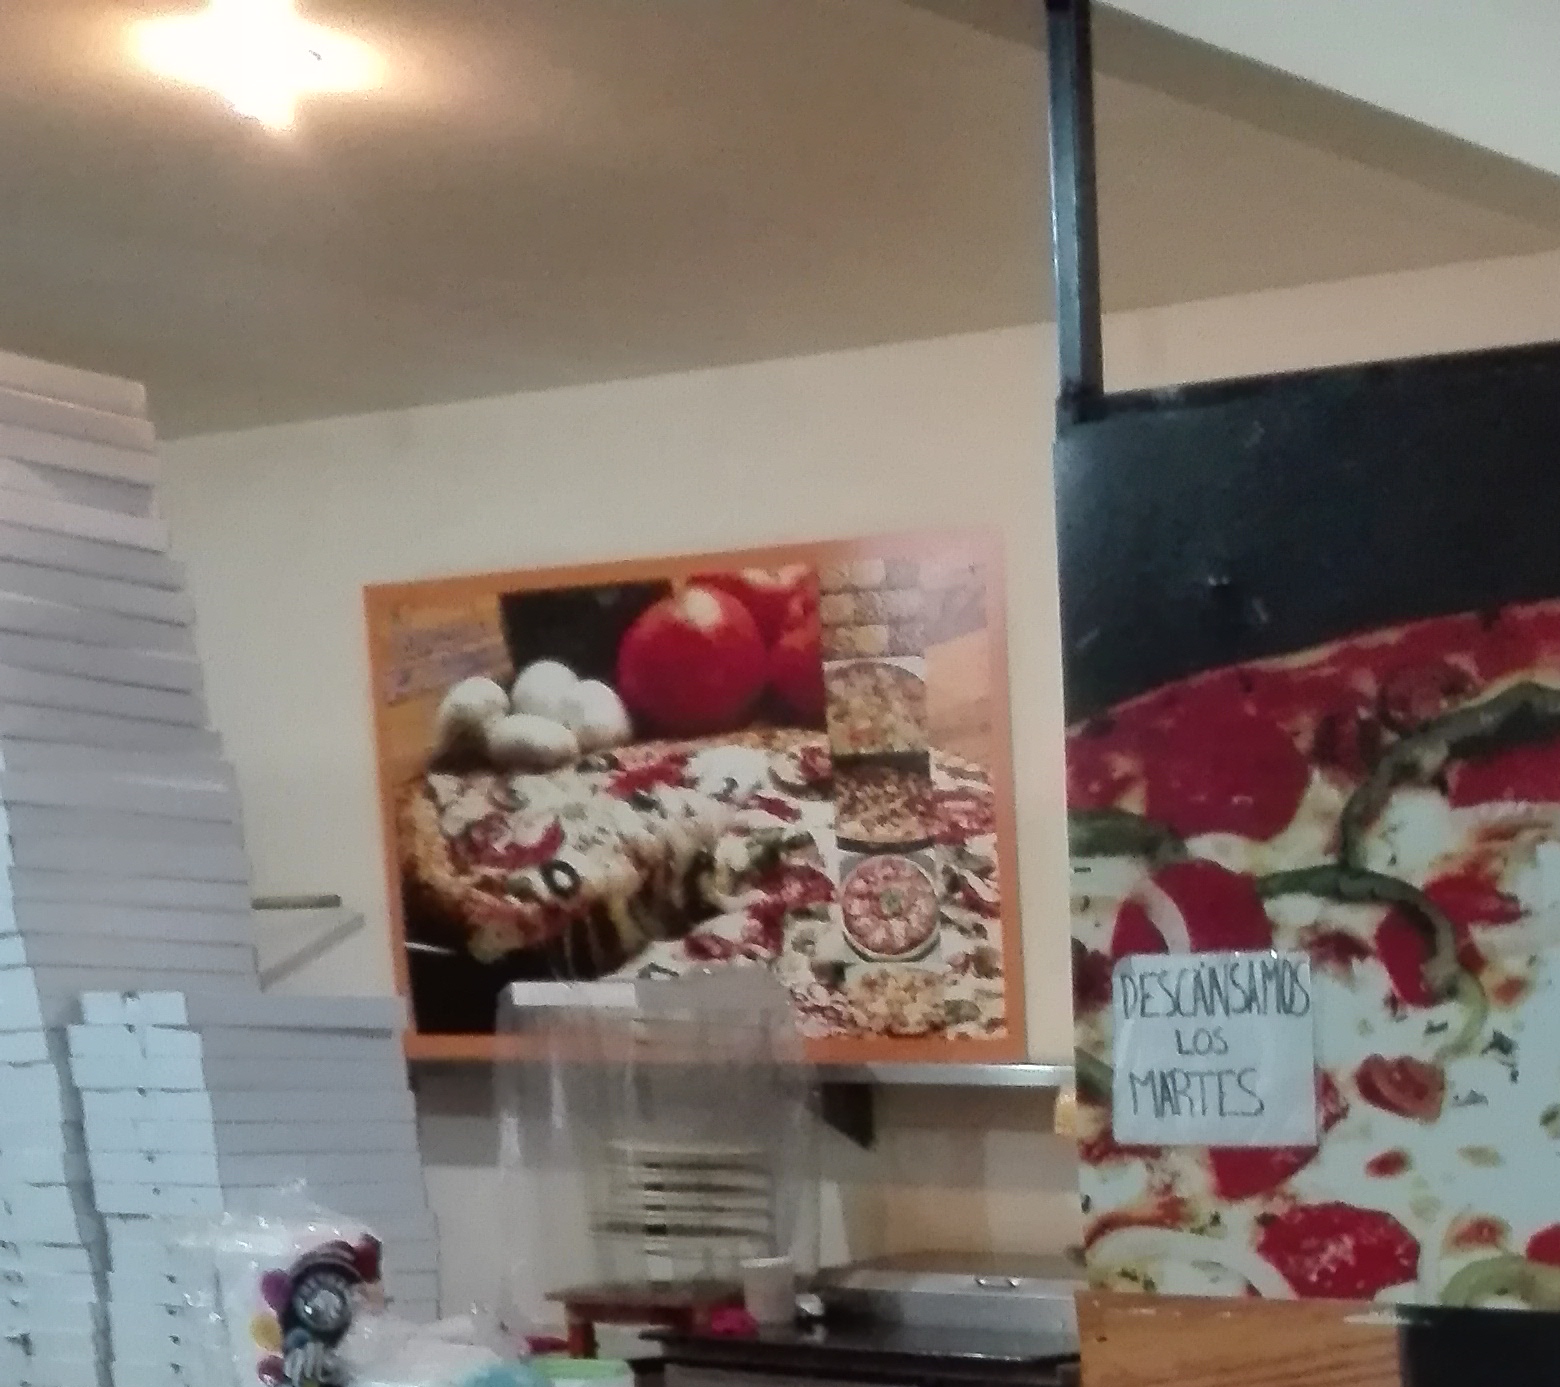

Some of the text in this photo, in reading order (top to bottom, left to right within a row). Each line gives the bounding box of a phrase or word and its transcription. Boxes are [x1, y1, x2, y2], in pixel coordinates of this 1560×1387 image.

[1120, 958, 1310, 1019] DESCANSAMOS
[1175, 1025, 1228, 1055] LOS
[1128, 1067, 1265, 1118] MARTES
